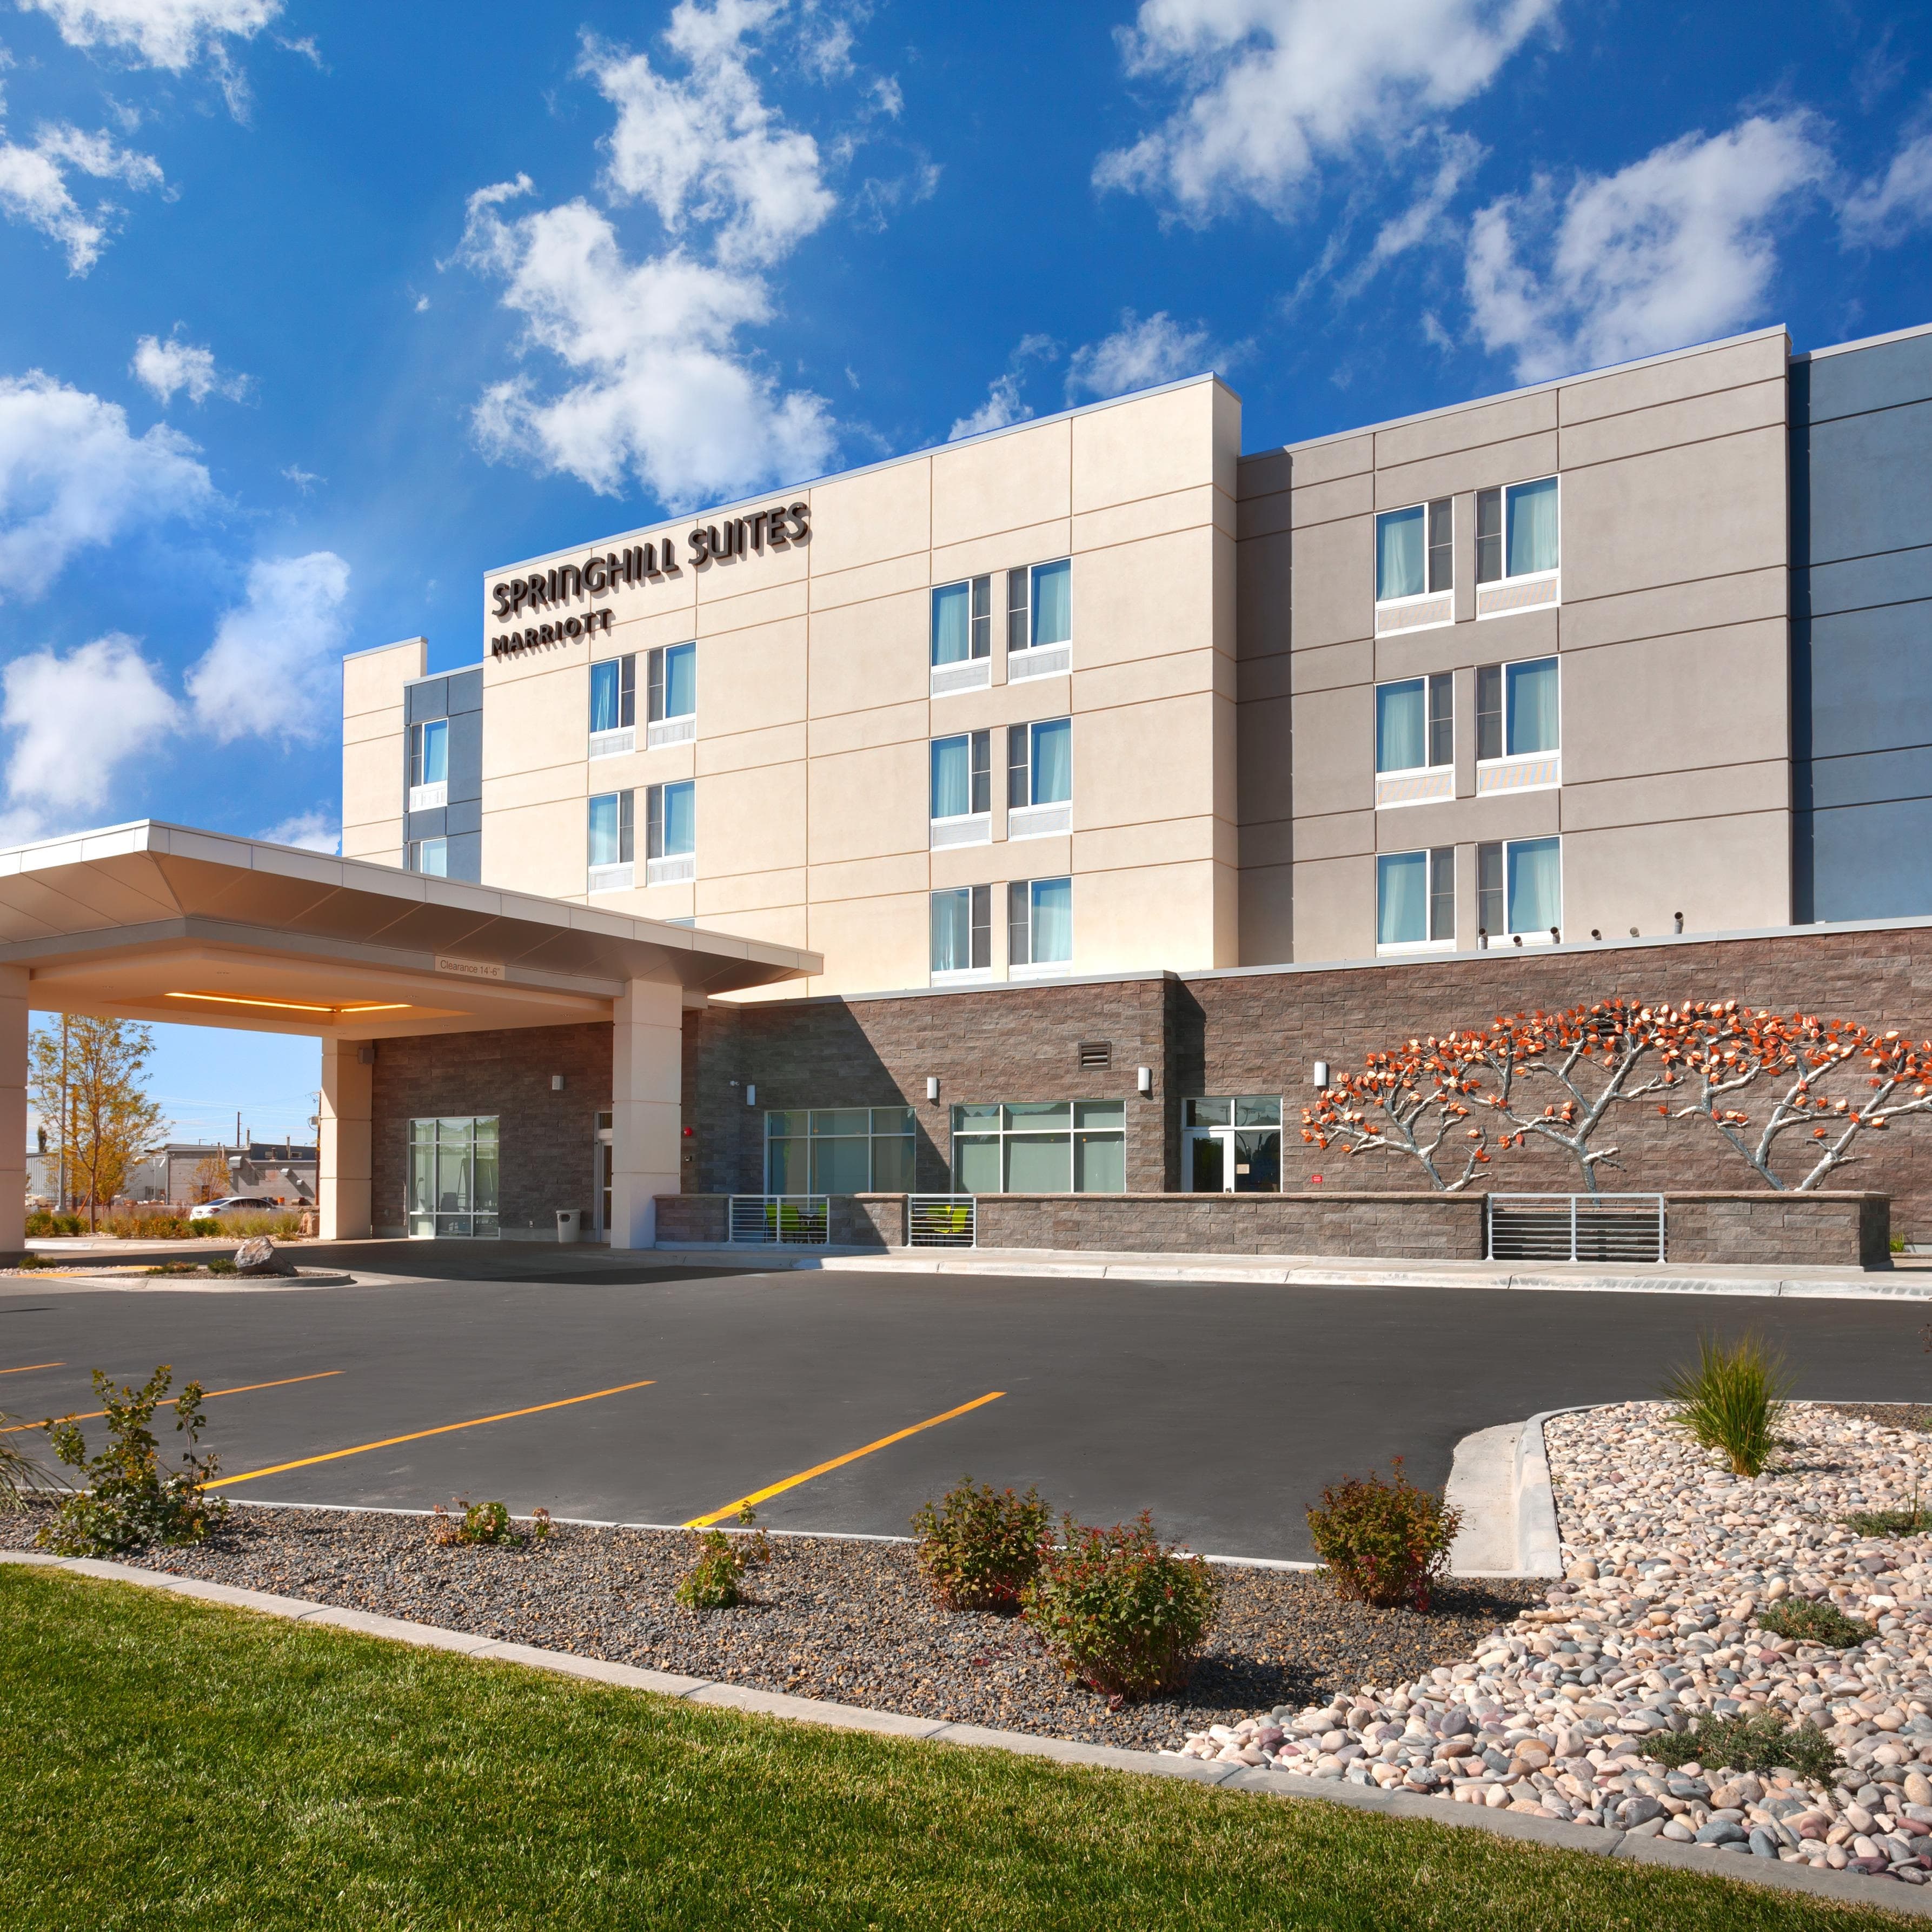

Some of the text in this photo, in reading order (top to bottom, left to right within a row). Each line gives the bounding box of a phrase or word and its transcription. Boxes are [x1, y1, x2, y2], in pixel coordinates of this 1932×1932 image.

[492, 501, 808, 617] SPRINGHILL SUITES
[491, 608, 612, 657] MARRIOTT
[440, 960, 478, 973] Clearance
